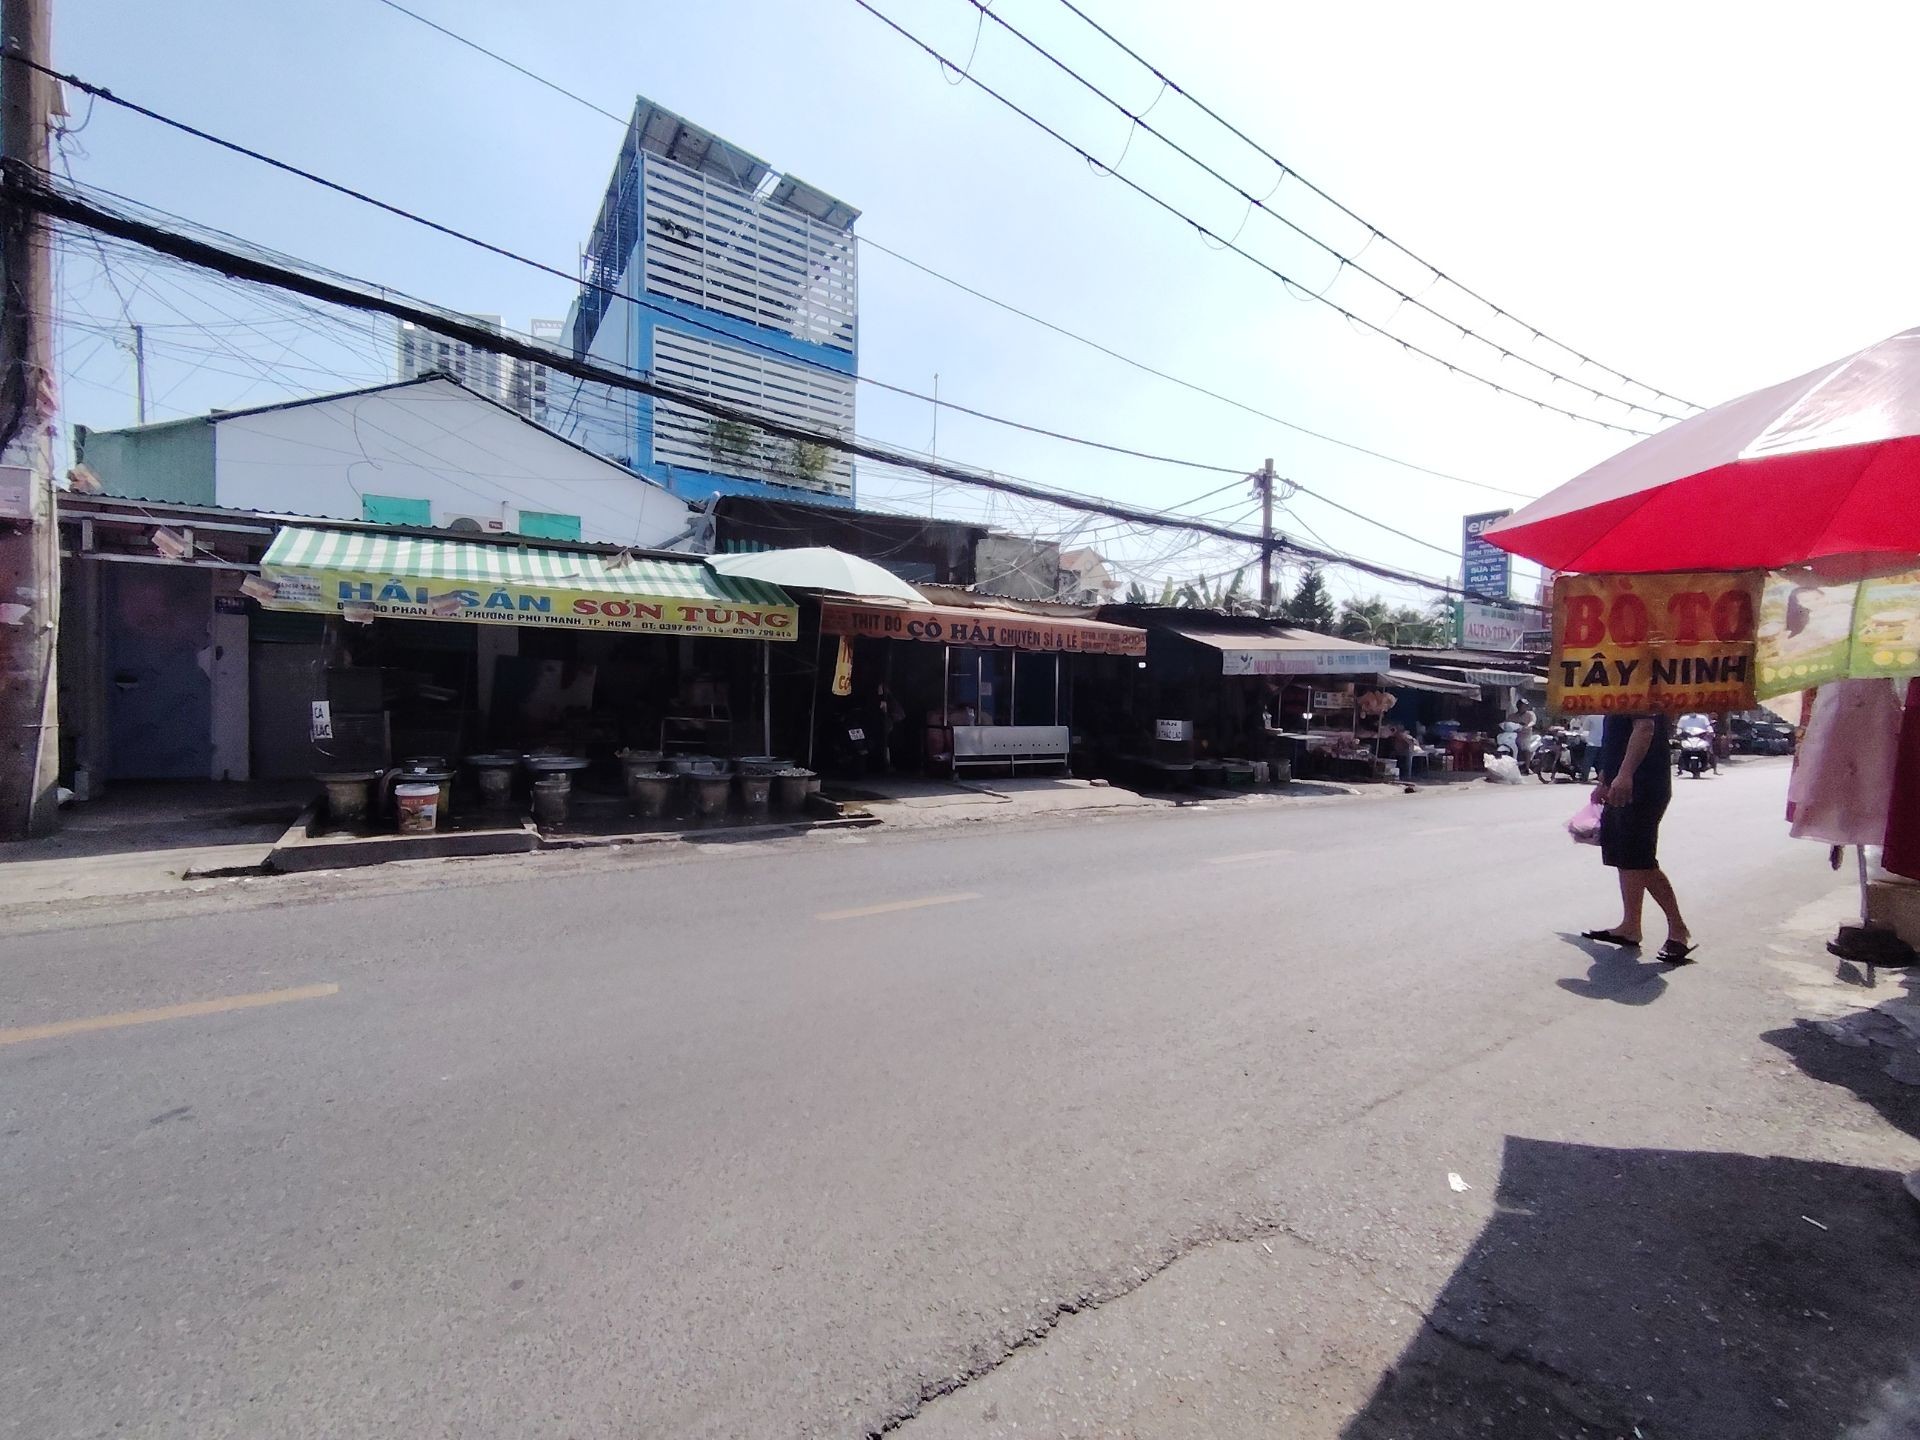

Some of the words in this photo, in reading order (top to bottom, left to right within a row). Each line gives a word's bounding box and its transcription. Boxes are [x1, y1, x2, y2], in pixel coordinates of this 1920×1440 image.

[339, 578, 428, 604] HẢI
[452, 586, 551, 612] SẢN
[572, 598, 664, 620] SƠN
[677, 604, 790, 628] TÙNG
[392, 605, 427, 615] PHAN
[607, 620, 631, 628] HCM
[1562, 578, 1649, 649] BÒ
[907, 617, 942, 638] CÔ
[950, 619, 996, 642] HẢI
[1056, 634, 1063, 648] &
[1560, 652, 1639, 688] TÂY
[1651, 655, 1748, 686] NINH
